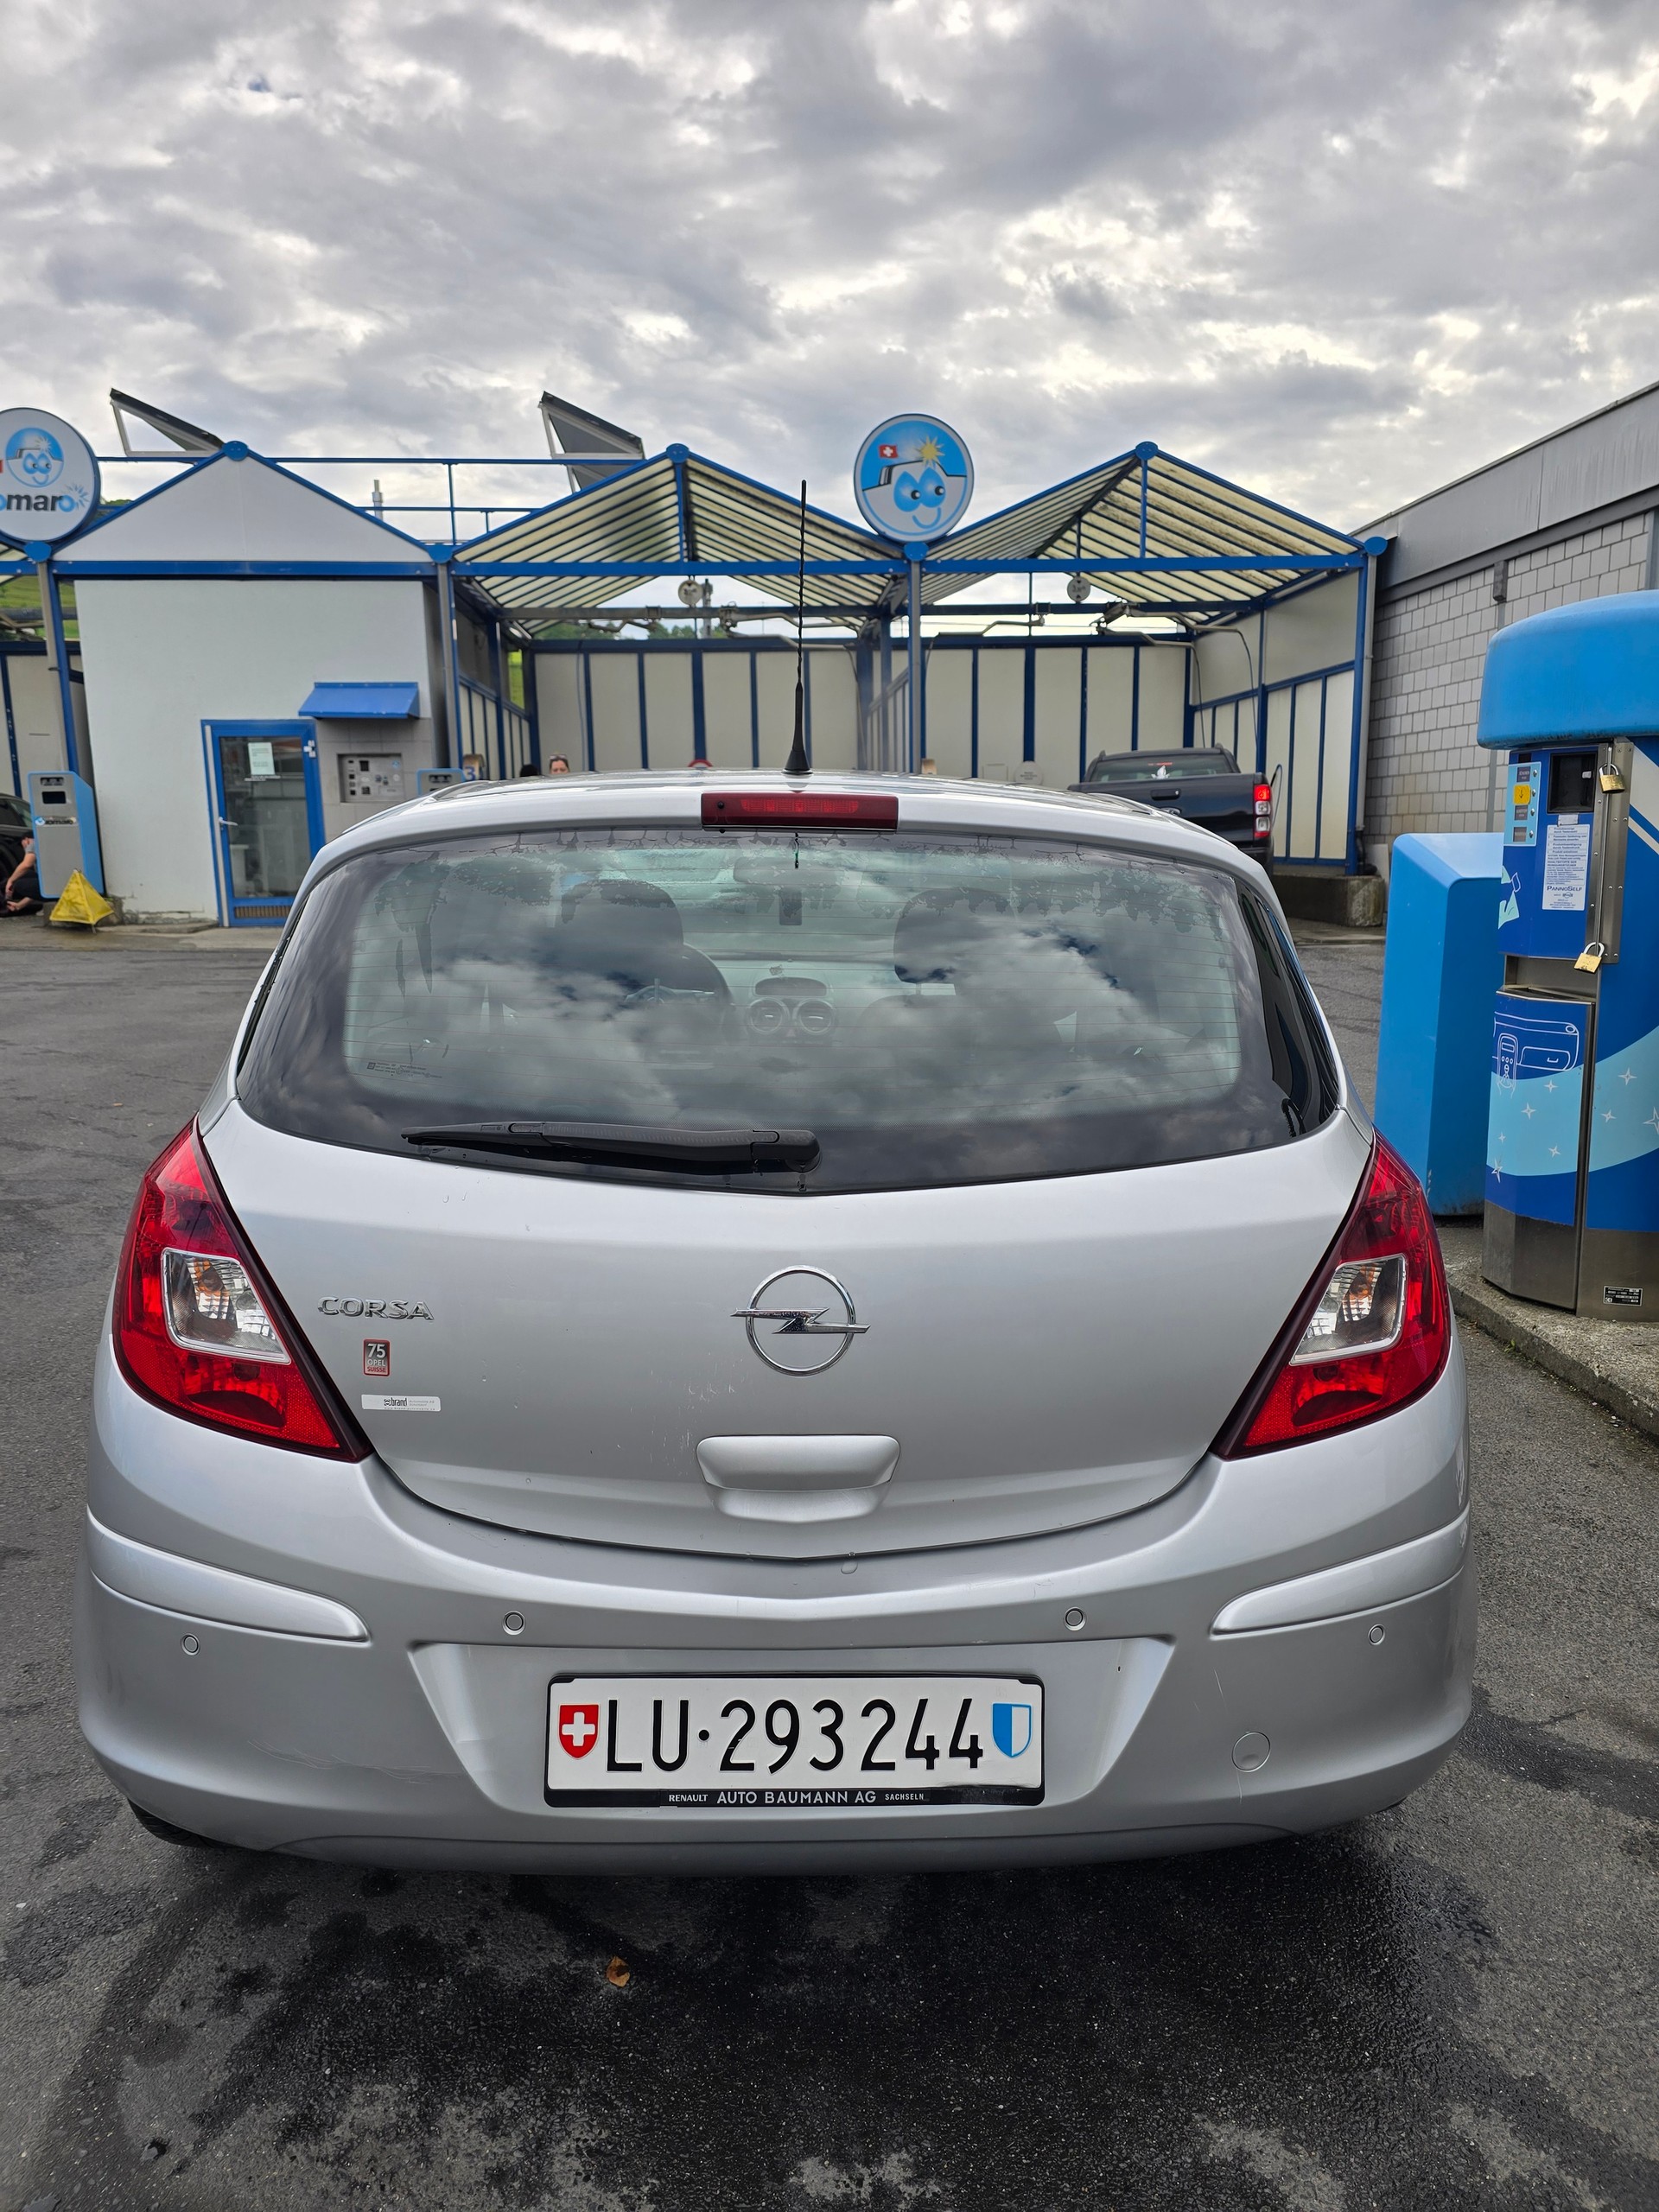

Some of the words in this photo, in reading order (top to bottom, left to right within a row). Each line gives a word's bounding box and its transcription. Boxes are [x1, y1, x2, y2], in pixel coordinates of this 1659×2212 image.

[317, 1296, 434, 1320] CORSA
[367, 1343, 386, 1358] 75
[367, 1358, 386, 1367] OPEL
[668, 1794, 709, 1802] RENAULT
[716, 1791, 757, 1804] AUTO
[765, 1790, 849, 1804] BAUMANN
[855, 1790, 877, 1804] AG
